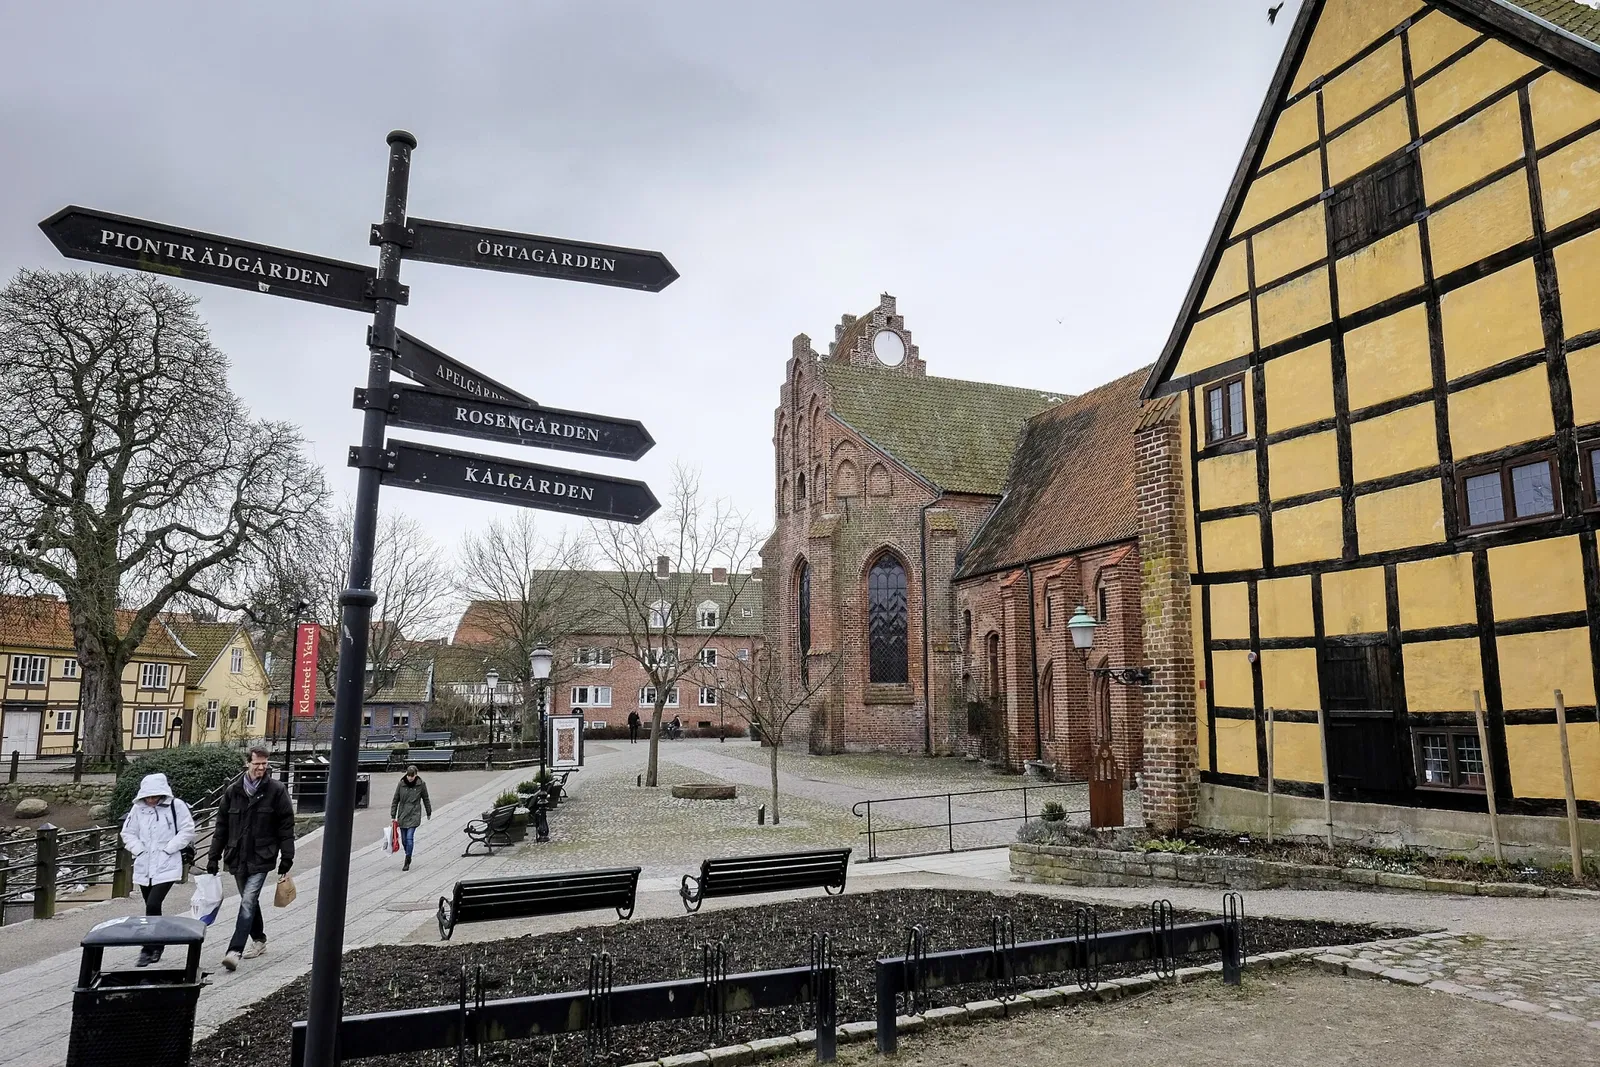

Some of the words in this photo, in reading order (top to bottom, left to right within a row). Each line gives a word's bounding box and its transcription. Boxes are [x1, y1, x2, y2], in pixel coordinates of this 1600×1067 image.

[100, 229, 330, 287] PIONTRÄDGÅRDEN
[476, 239, 616, 272] ÖRTAGÅRDEN
[436, 364, 509, 401] APELGÅRD
[455, 406, 600, 442] ROSENGÅRDEN
[464, 466, 595, 501] KÅLGÅRDEN
[303, 626, 315, 657] Ystad
[299, 666, 312, 713] Klostret
